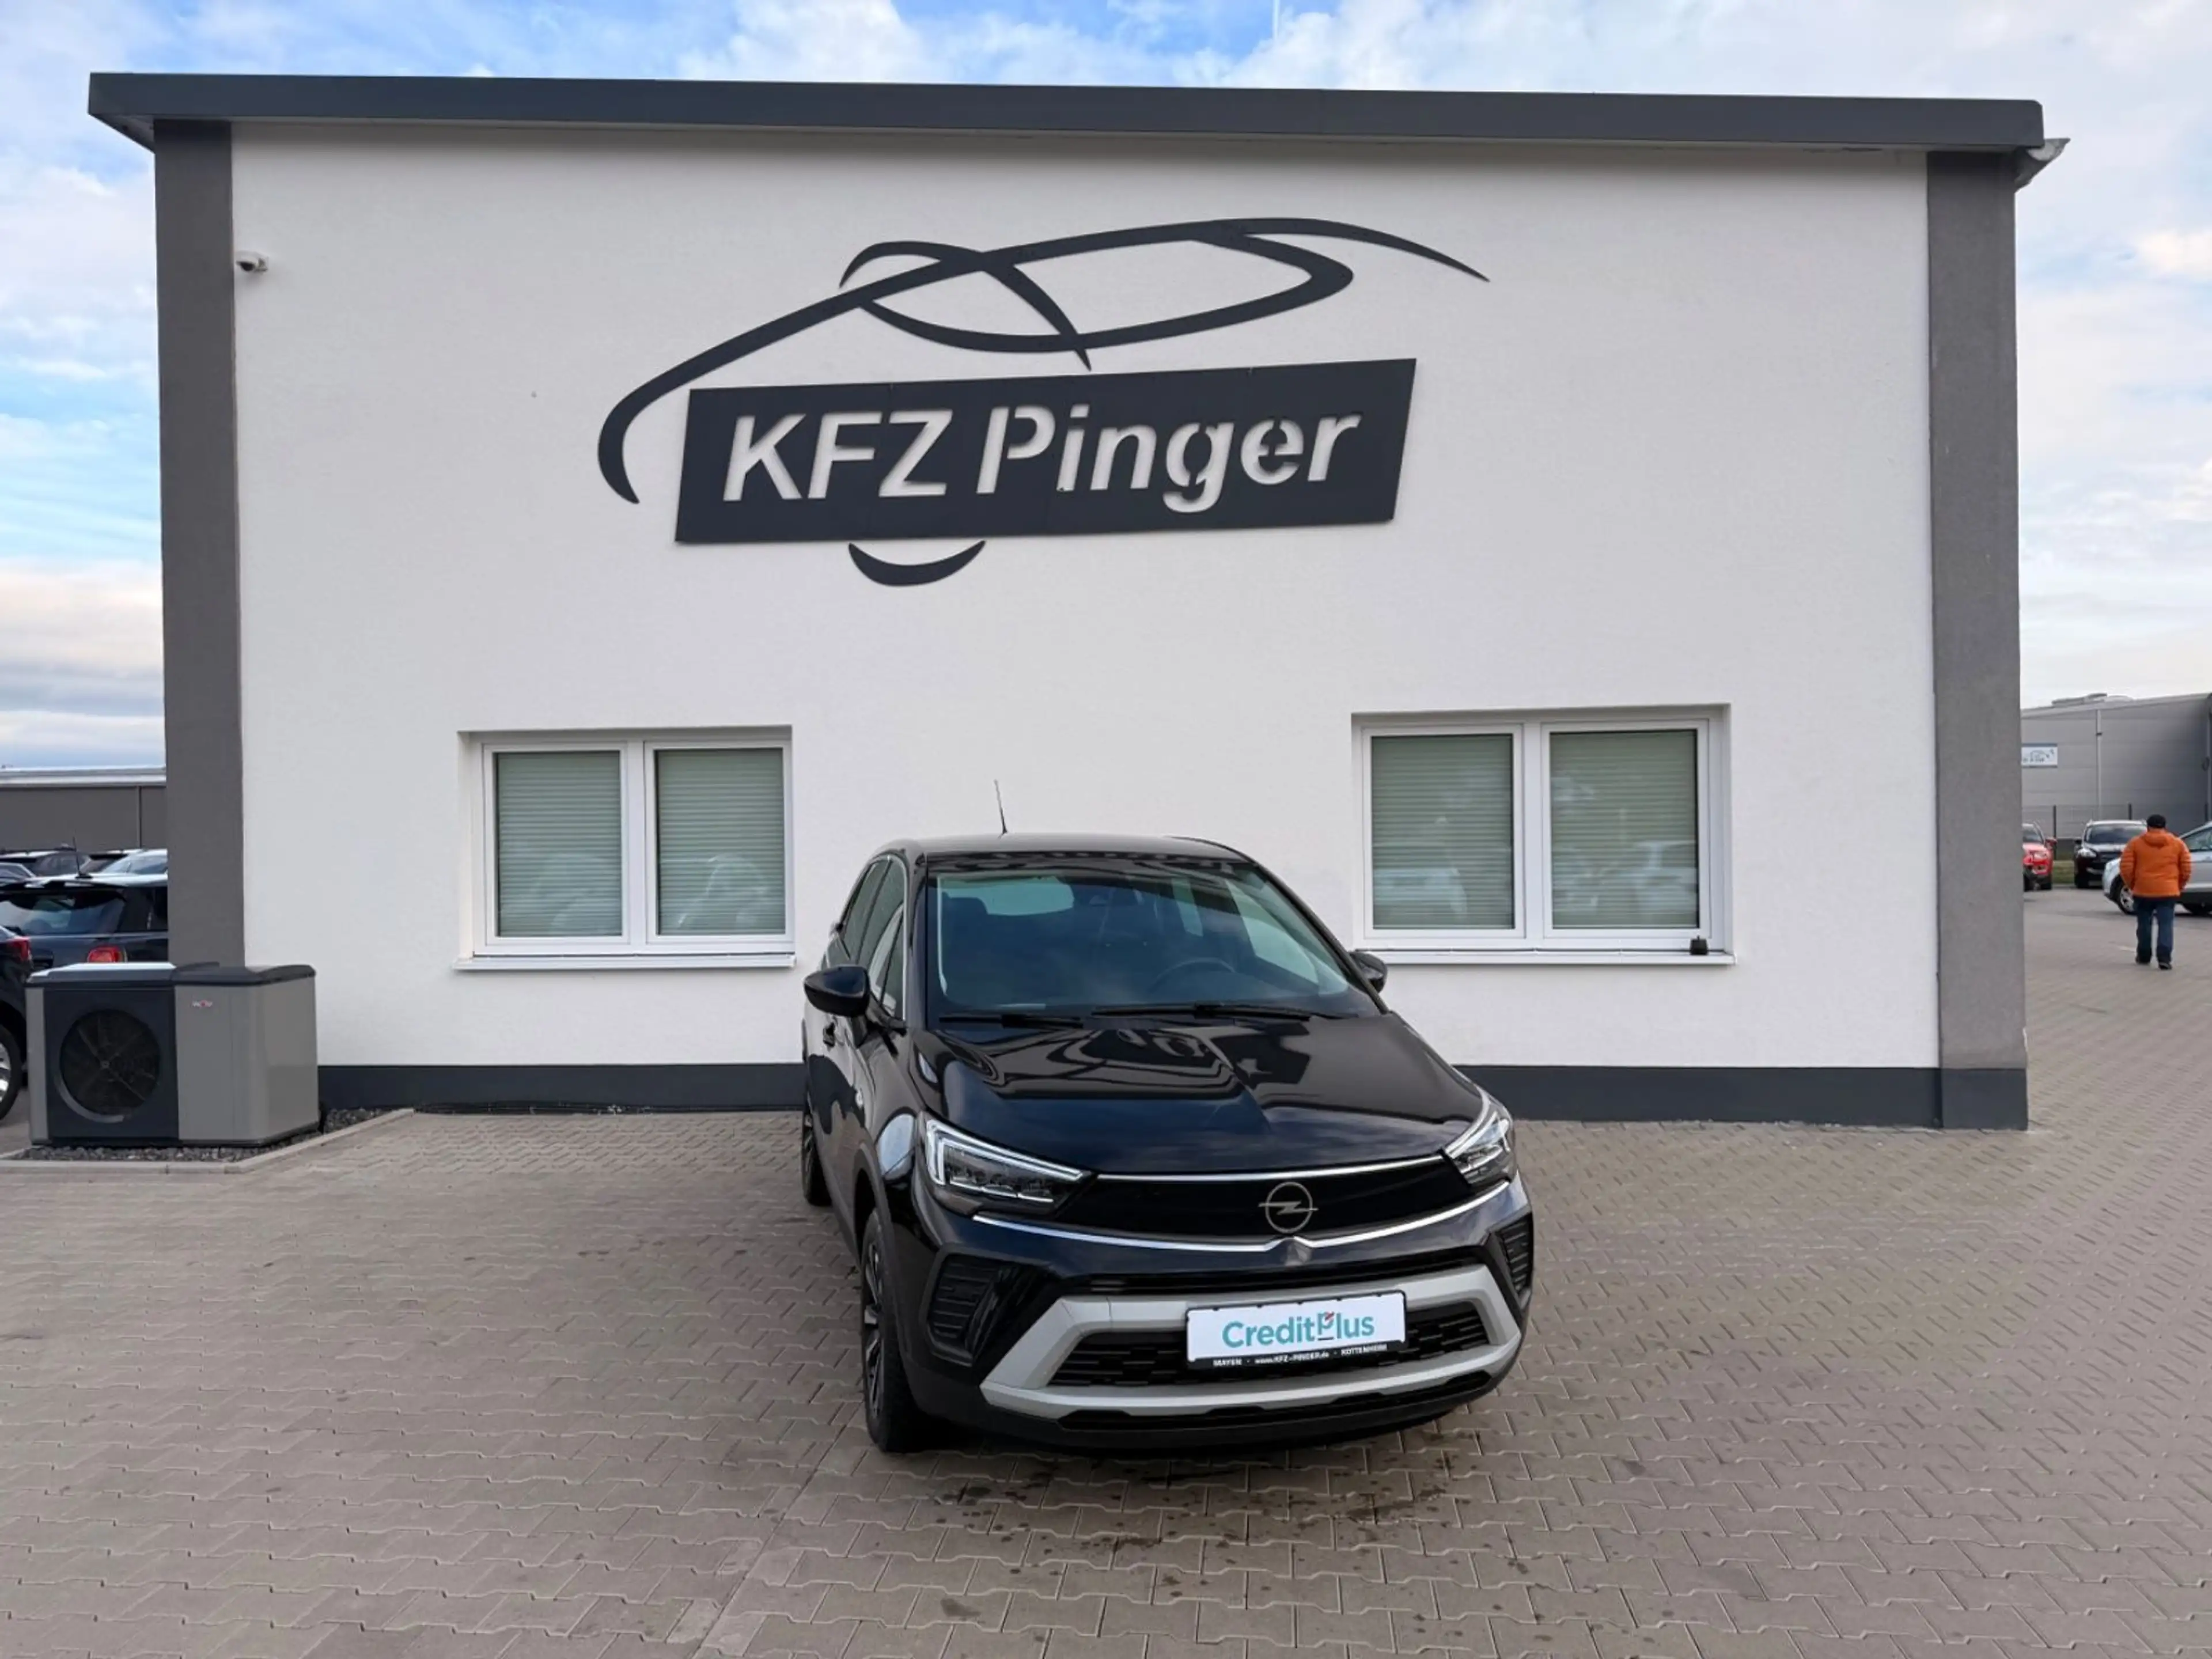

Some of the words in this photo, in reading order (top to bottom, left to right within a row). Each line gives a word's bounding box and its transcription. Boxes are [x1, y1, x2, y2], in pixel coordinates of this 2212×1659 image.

[723, 410, 952, 501] KFZ
[976, 404, 1360, 512] Pinger
[1222, 1311, 1374, 1348] CreditPlus
